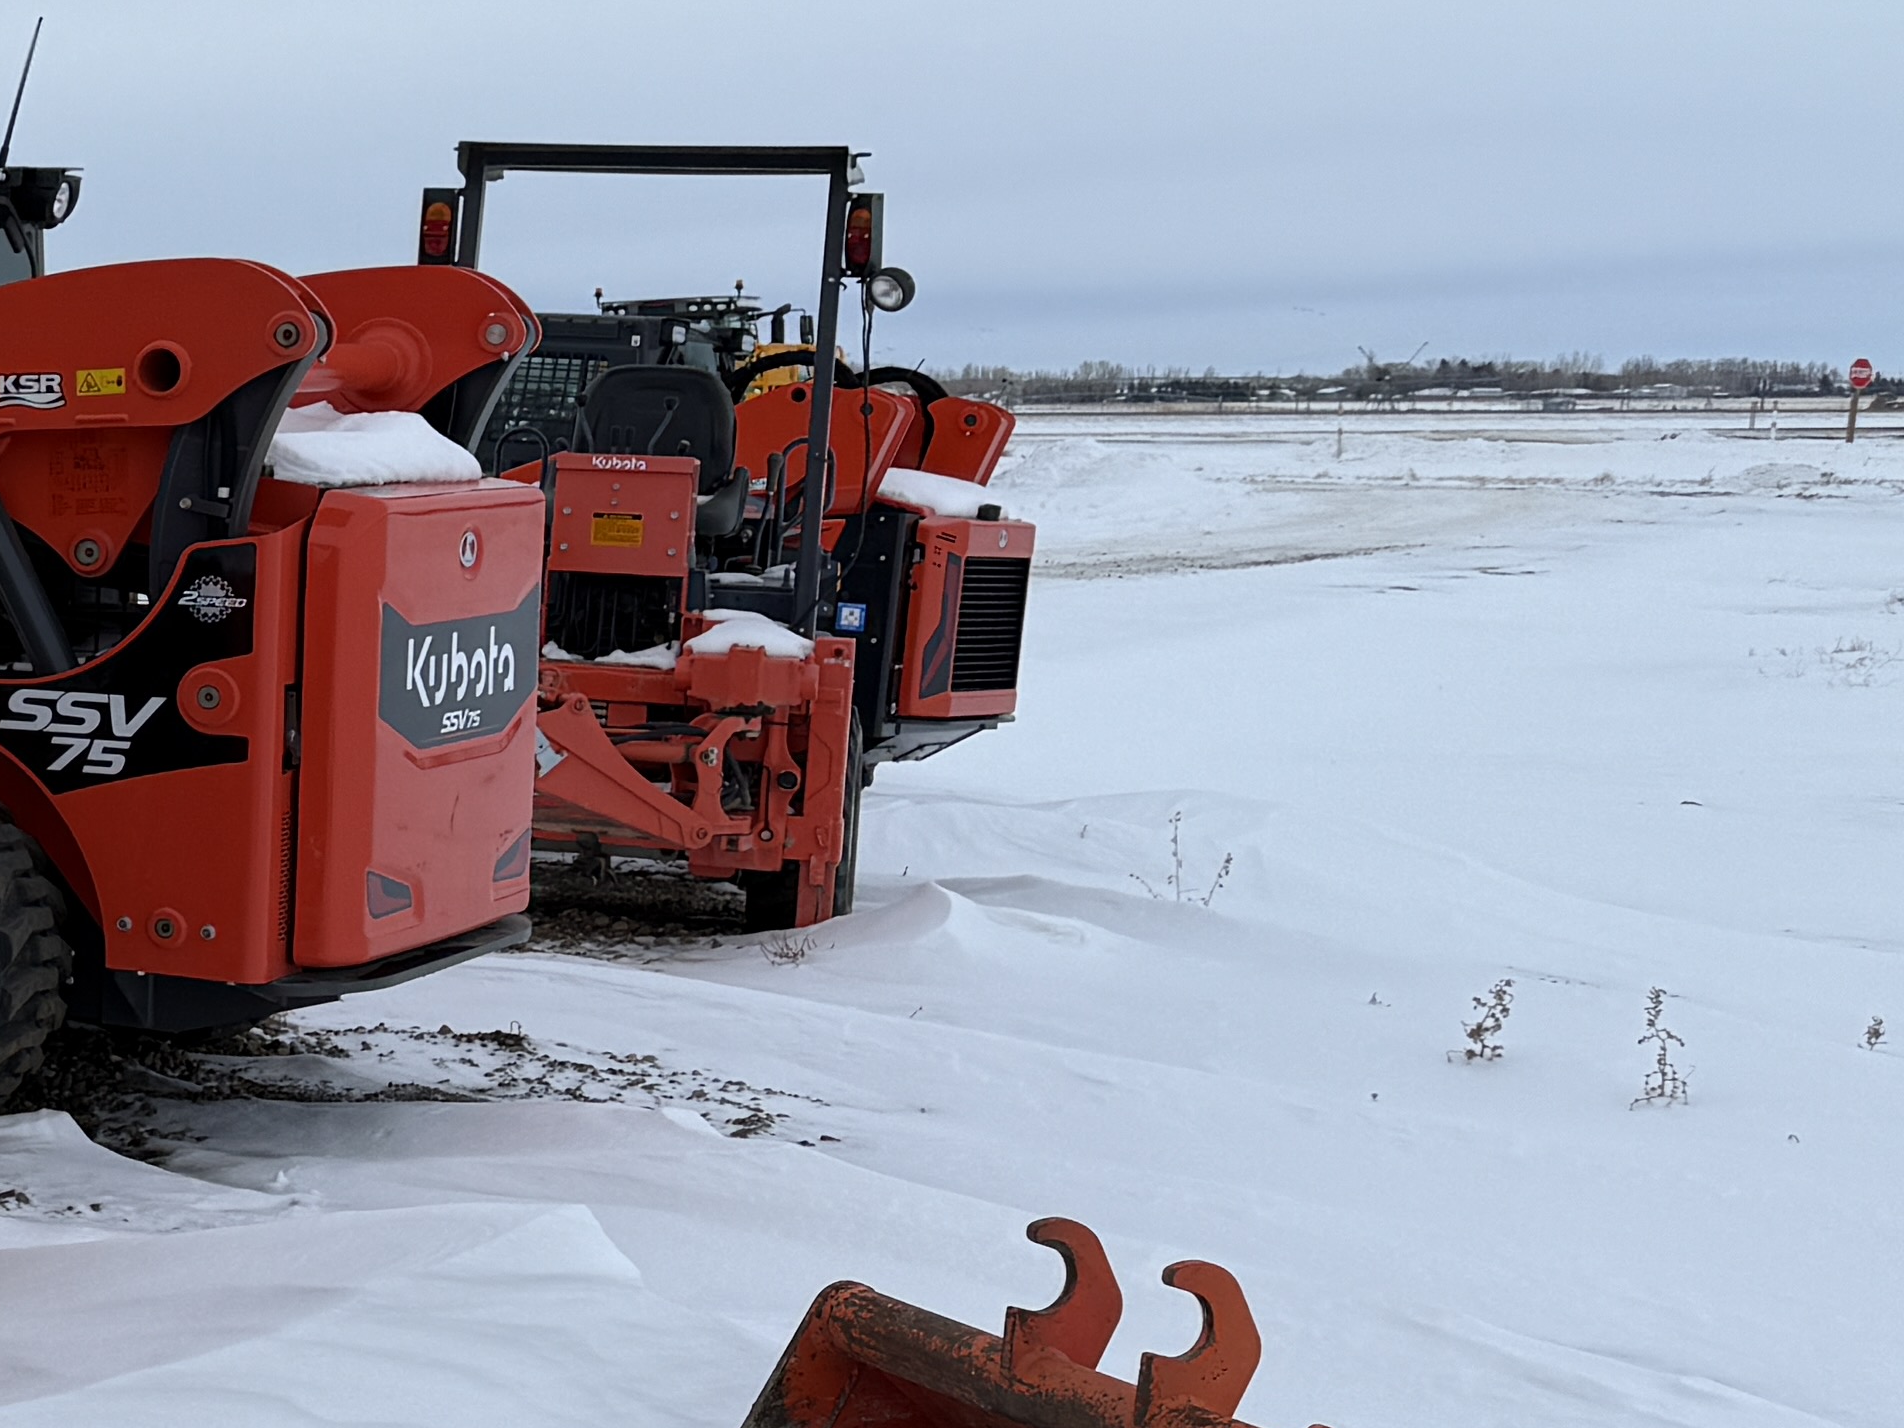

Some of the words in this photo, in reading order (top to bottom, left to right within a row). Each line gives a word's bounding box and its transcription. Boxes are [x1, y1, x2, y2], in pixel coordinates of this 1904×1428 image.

[592, 455, 647, 471] Kubota
[406, 625, 515, 708] Kubota
[46, 736, 132, 775] 75
